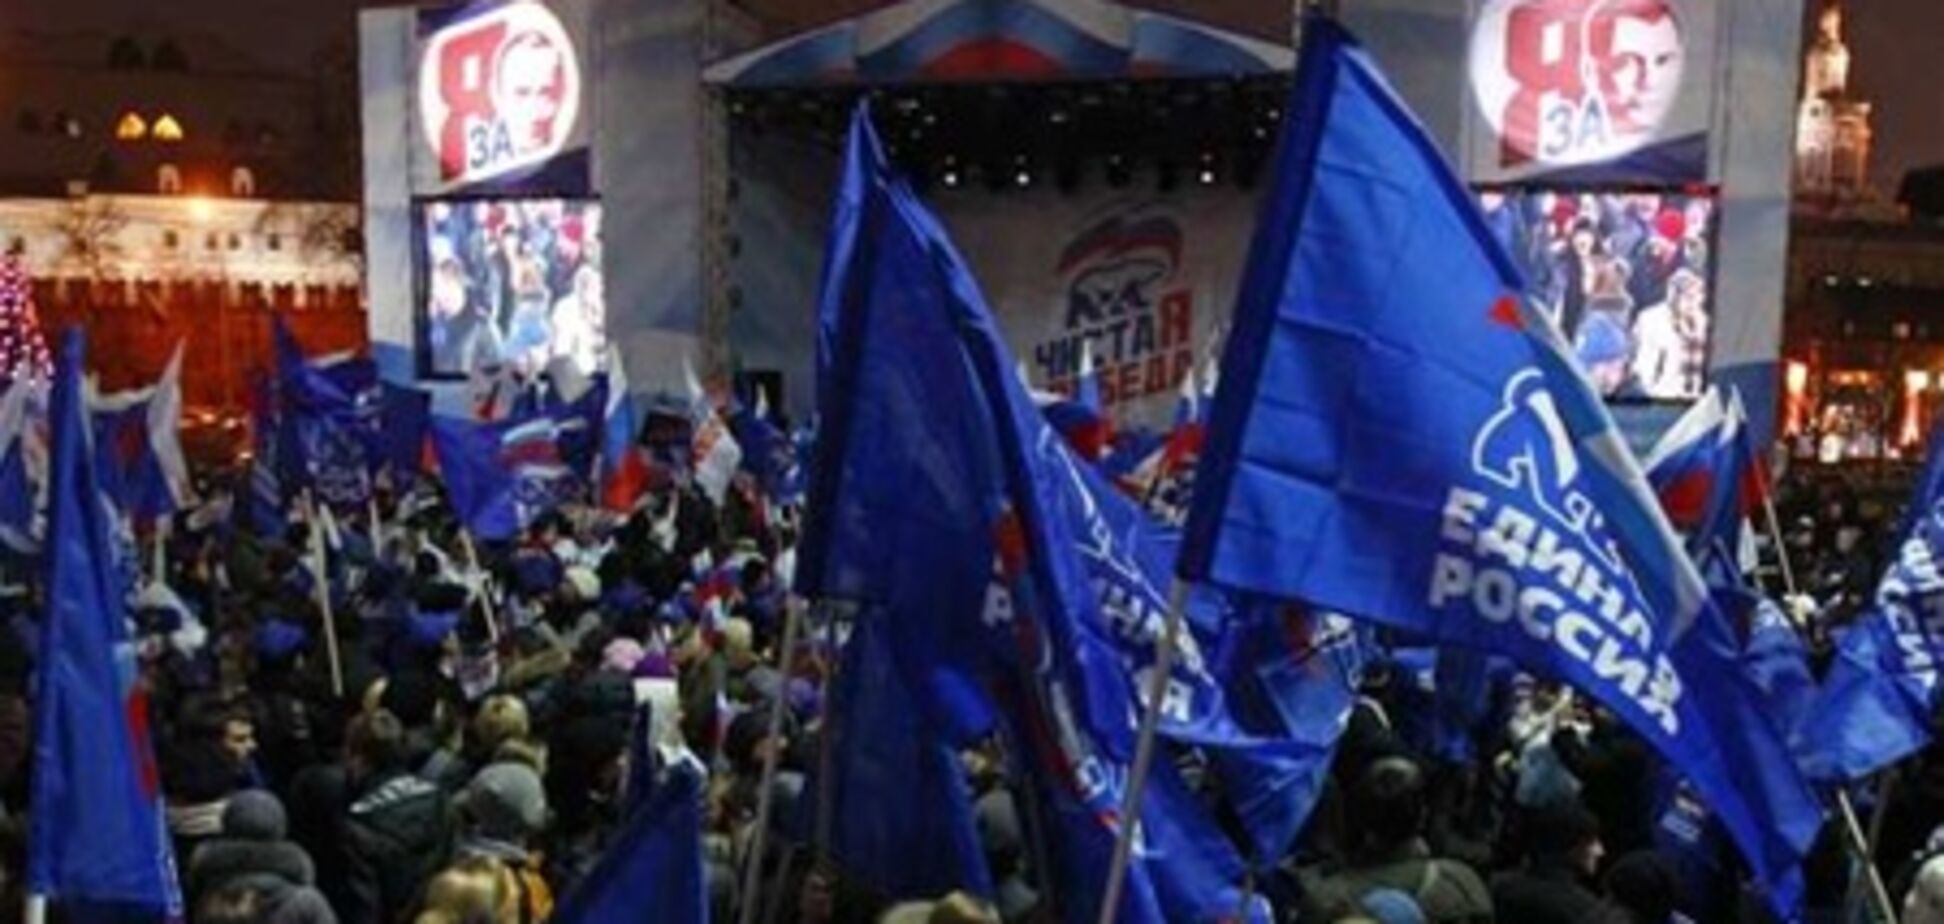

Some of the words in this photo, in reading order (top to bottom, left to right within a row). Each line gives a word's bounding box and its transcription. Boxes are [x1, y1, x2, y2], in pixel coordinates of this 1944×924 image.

[440, 20, 507, 182] Я
[1428, 551, 1683, 737] РОССИЯ
[1441, 486, 1654, 653] ЕДИНА
